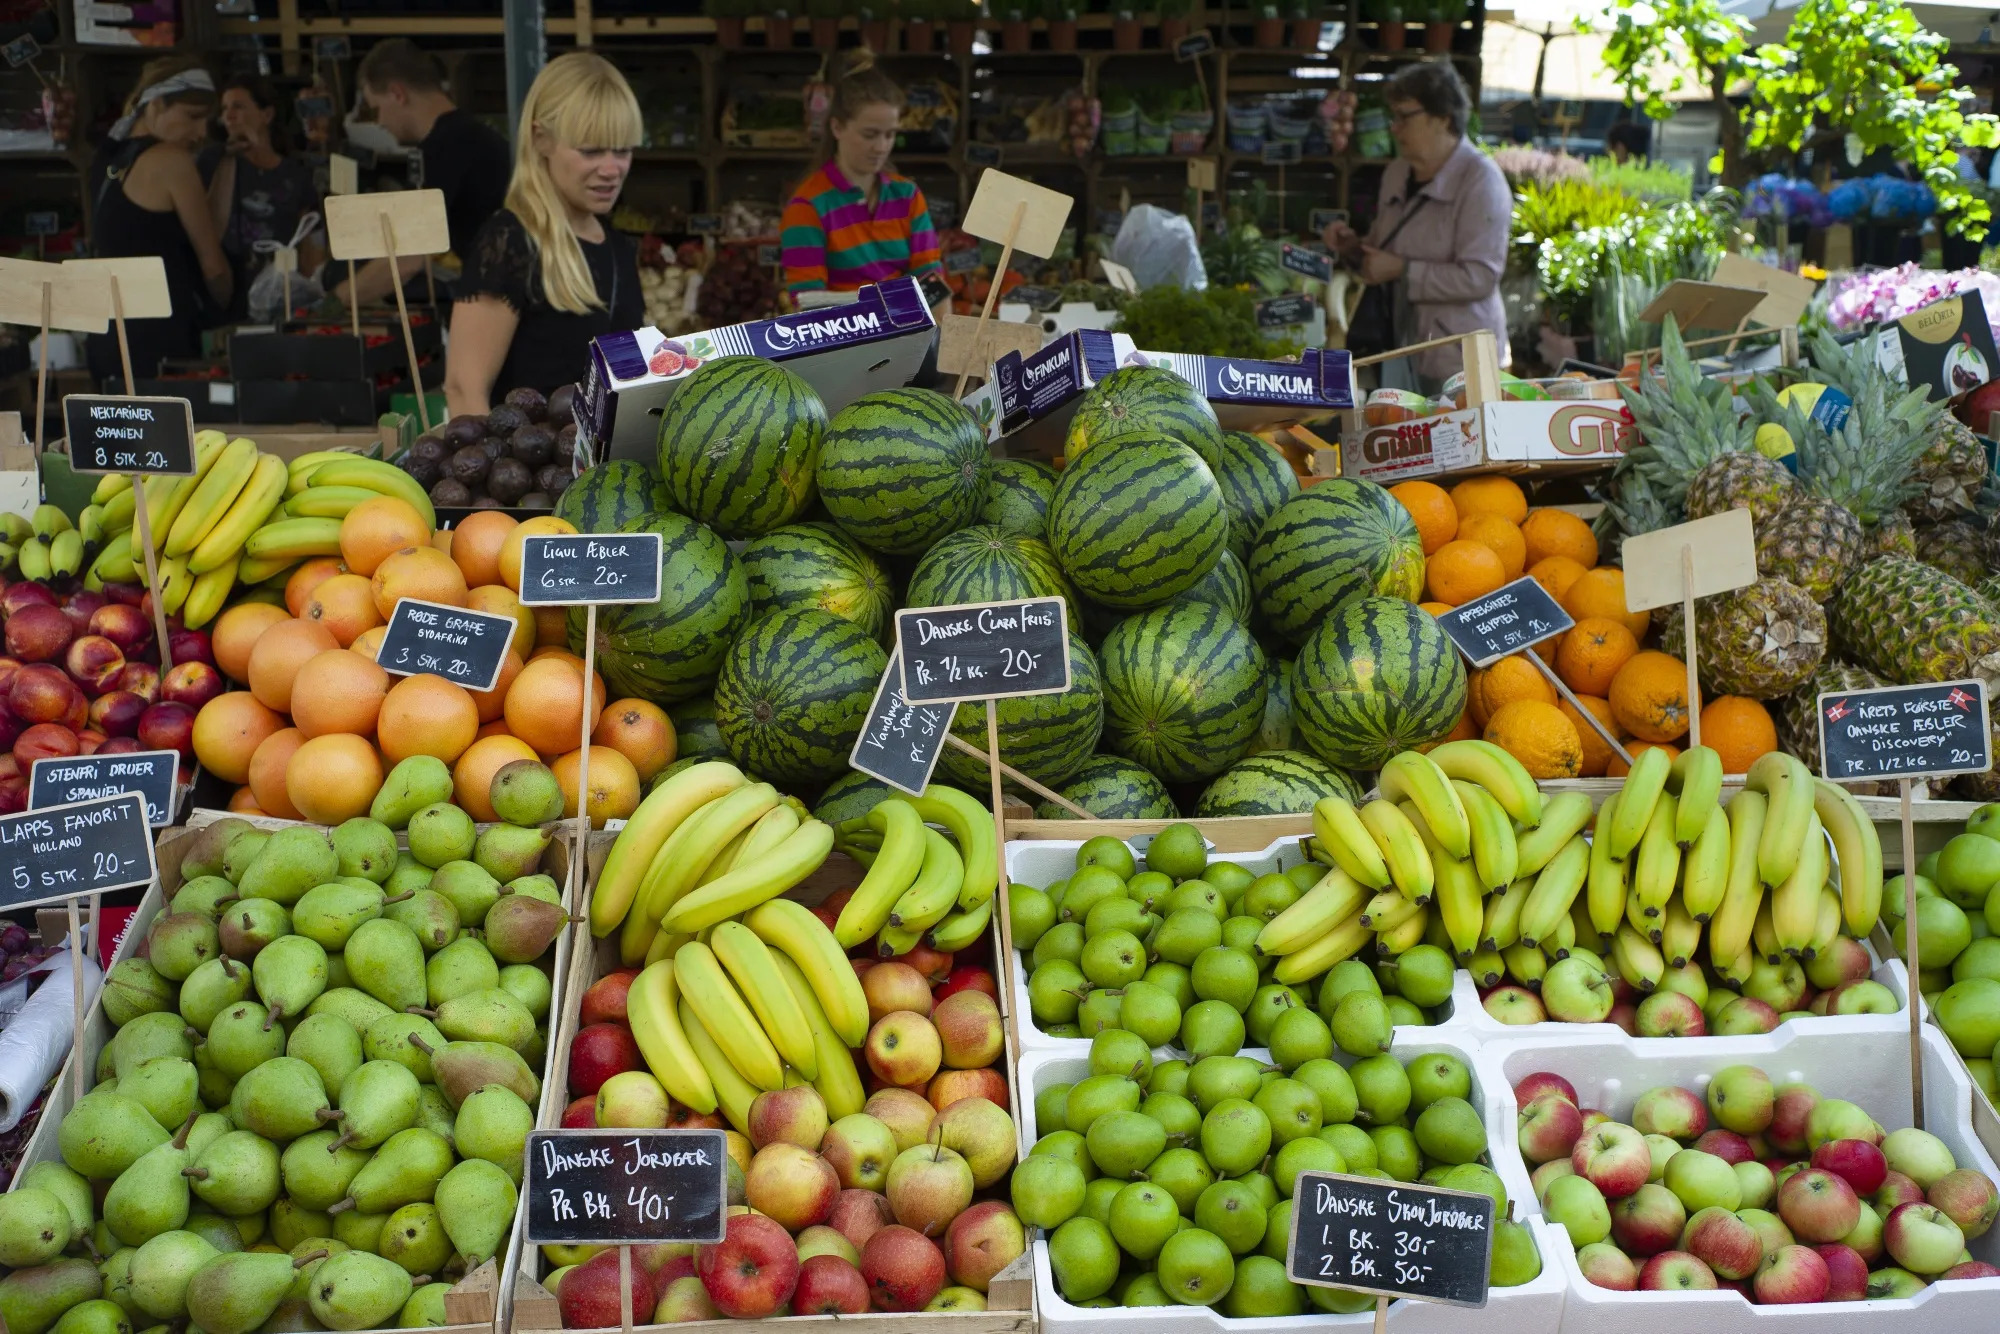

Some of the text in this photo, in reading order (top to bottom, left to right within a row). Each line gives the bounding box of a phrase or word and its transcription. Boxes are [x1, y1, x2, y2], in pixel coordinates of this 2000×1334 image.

[801, 327, 883, 348] AGRICULTURE
[1246, 391, 1314, 401] AGRICULTURE
[95, 447, 107, 466] 8
[114, 452, 143, 467] STK.
[586, 541, 630, 560] ÆBLER
[541, 568, 555, 588] 6
[558, 577, 580, 587] STK.
[407, 609, 485, 636] RØDE GRAPE
[1475, 609, 1520, 635] EGYPTEN
[1486, 639, 1501, 651] 4
[396, 647, 410, 664] 3
[417, 653, 442, 671] STK.
[940, 655, 963, 683] 1/2
[1858, 701, 1897, 719] ÅRETS
[1847, 714, 1967, 738] DANSKE ÆBLER
[910, 742, 926, 763] pr.
[1846, 760, 1871, 773] PR.
[1879, 757, 1903, 771] 1/2
[146, 802, 165, 822] 0.-
[32, 835, 82, 854] HOLLAND
[12, 866, 31, 889] 5
[41, 868, 85, 887] STK.
[583, 1190, 617, 1220] BK.
[1322, 1224, 1333, 1246] 1.
[1349, 1228, 1380, 1250] BK.
[1318, 1254, 1341, 1277] 2.
[1350, 1251, 1383, 1277] BK.
